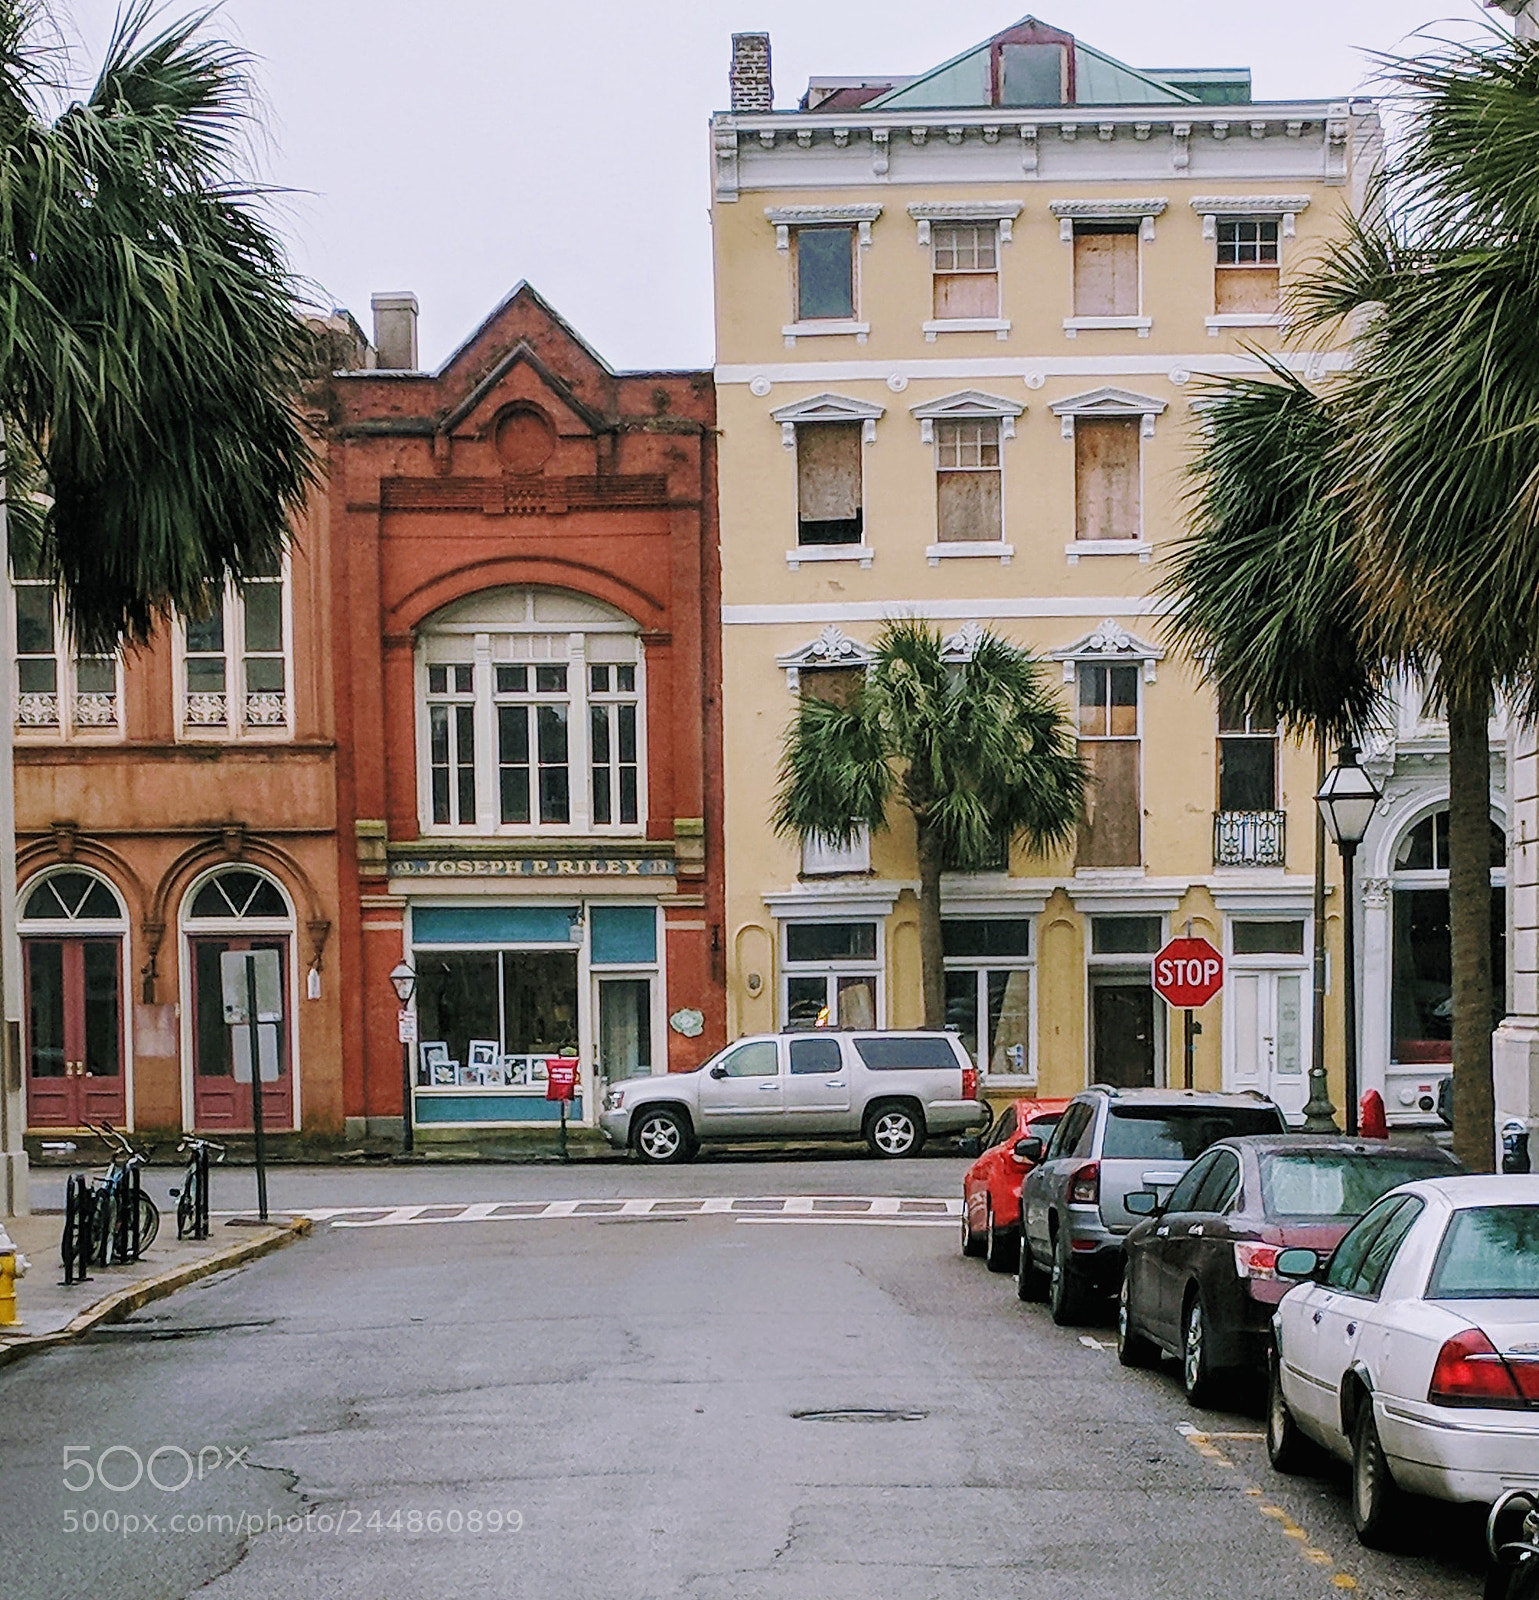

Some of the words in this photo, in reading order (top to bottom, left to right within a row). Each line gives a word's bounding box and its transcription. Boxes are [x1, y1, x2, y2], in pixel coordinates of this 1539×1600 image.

[419, 860, 524, 876] JOSEPH
[555, 859, 644, 875] RILEY
[1157, 958, 1220, 987] STOP
